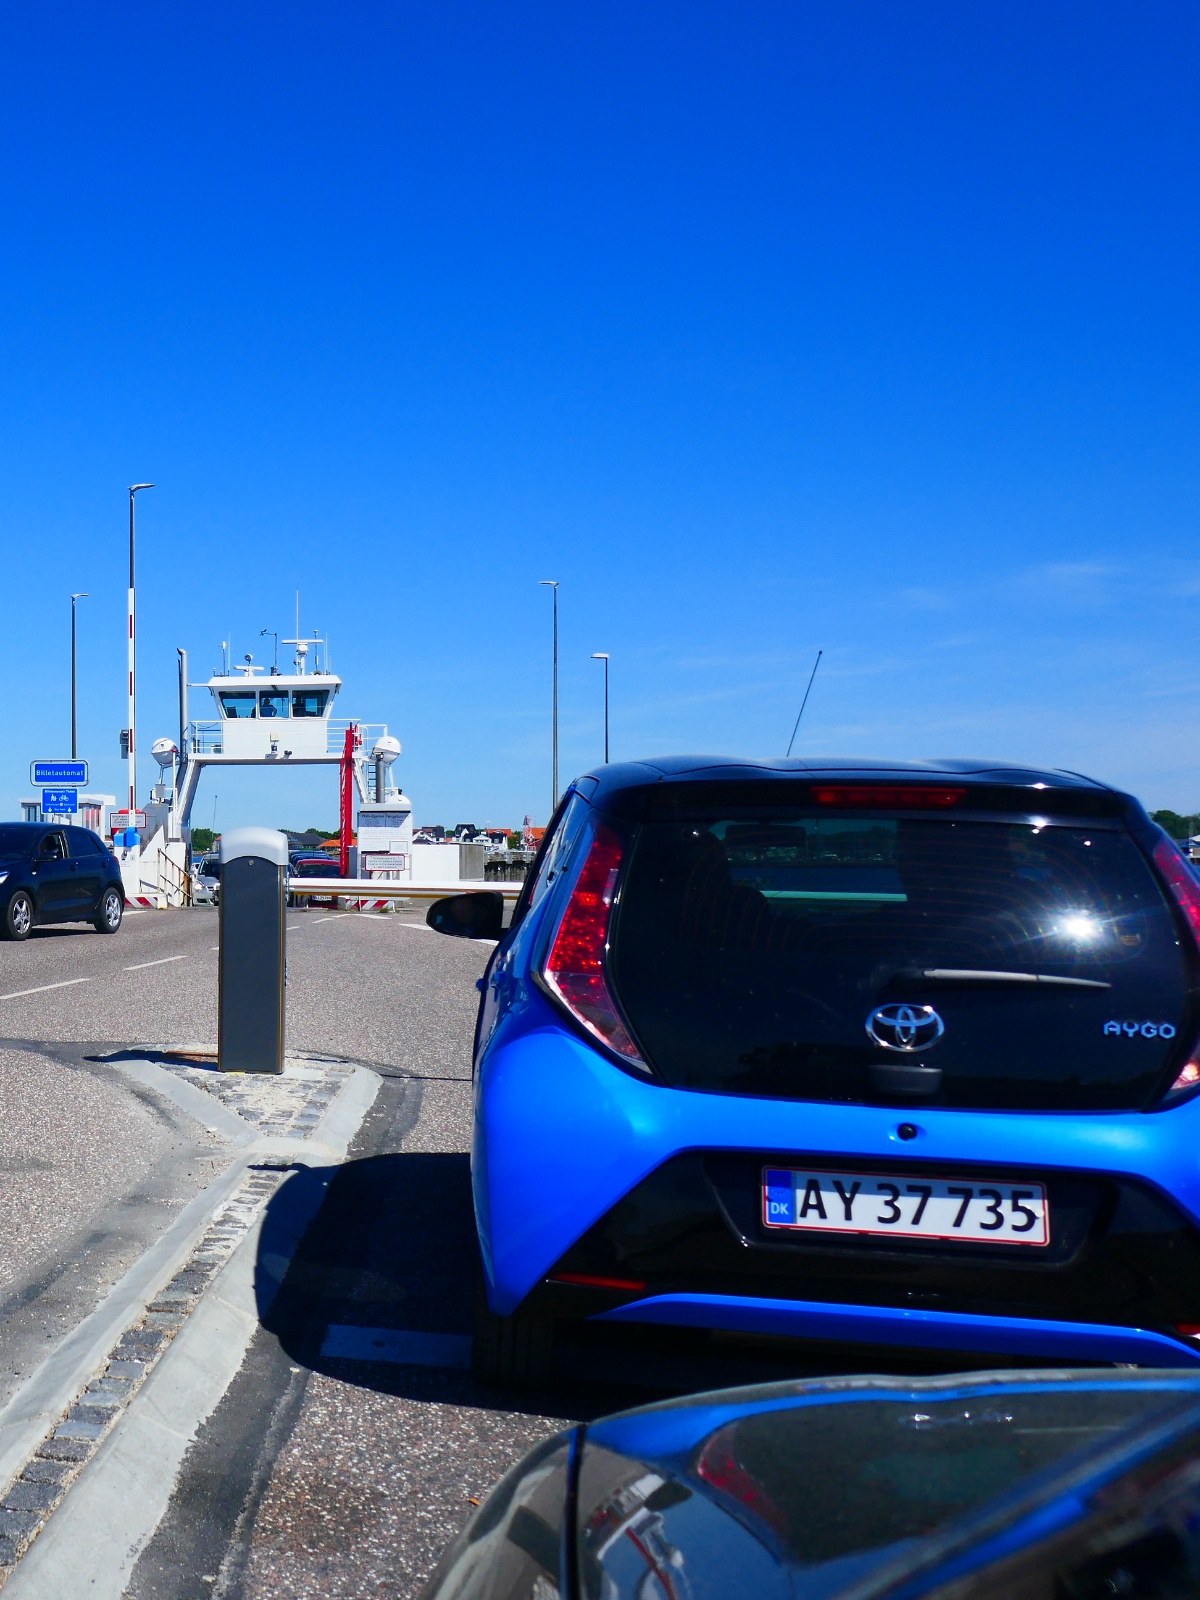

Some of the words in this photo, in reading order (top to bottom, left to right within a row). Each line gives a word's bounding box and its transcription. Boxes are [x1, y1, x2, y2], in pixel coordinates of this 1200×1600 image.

[1103, 1020, 1176, 1039] AYGO
[770, 1202, 789, 1215] DK
[799, 1178, 861, 1221] AY
[876, 1183, 932, 1226] 37
[947, 1187, 1038, 1232] 735
